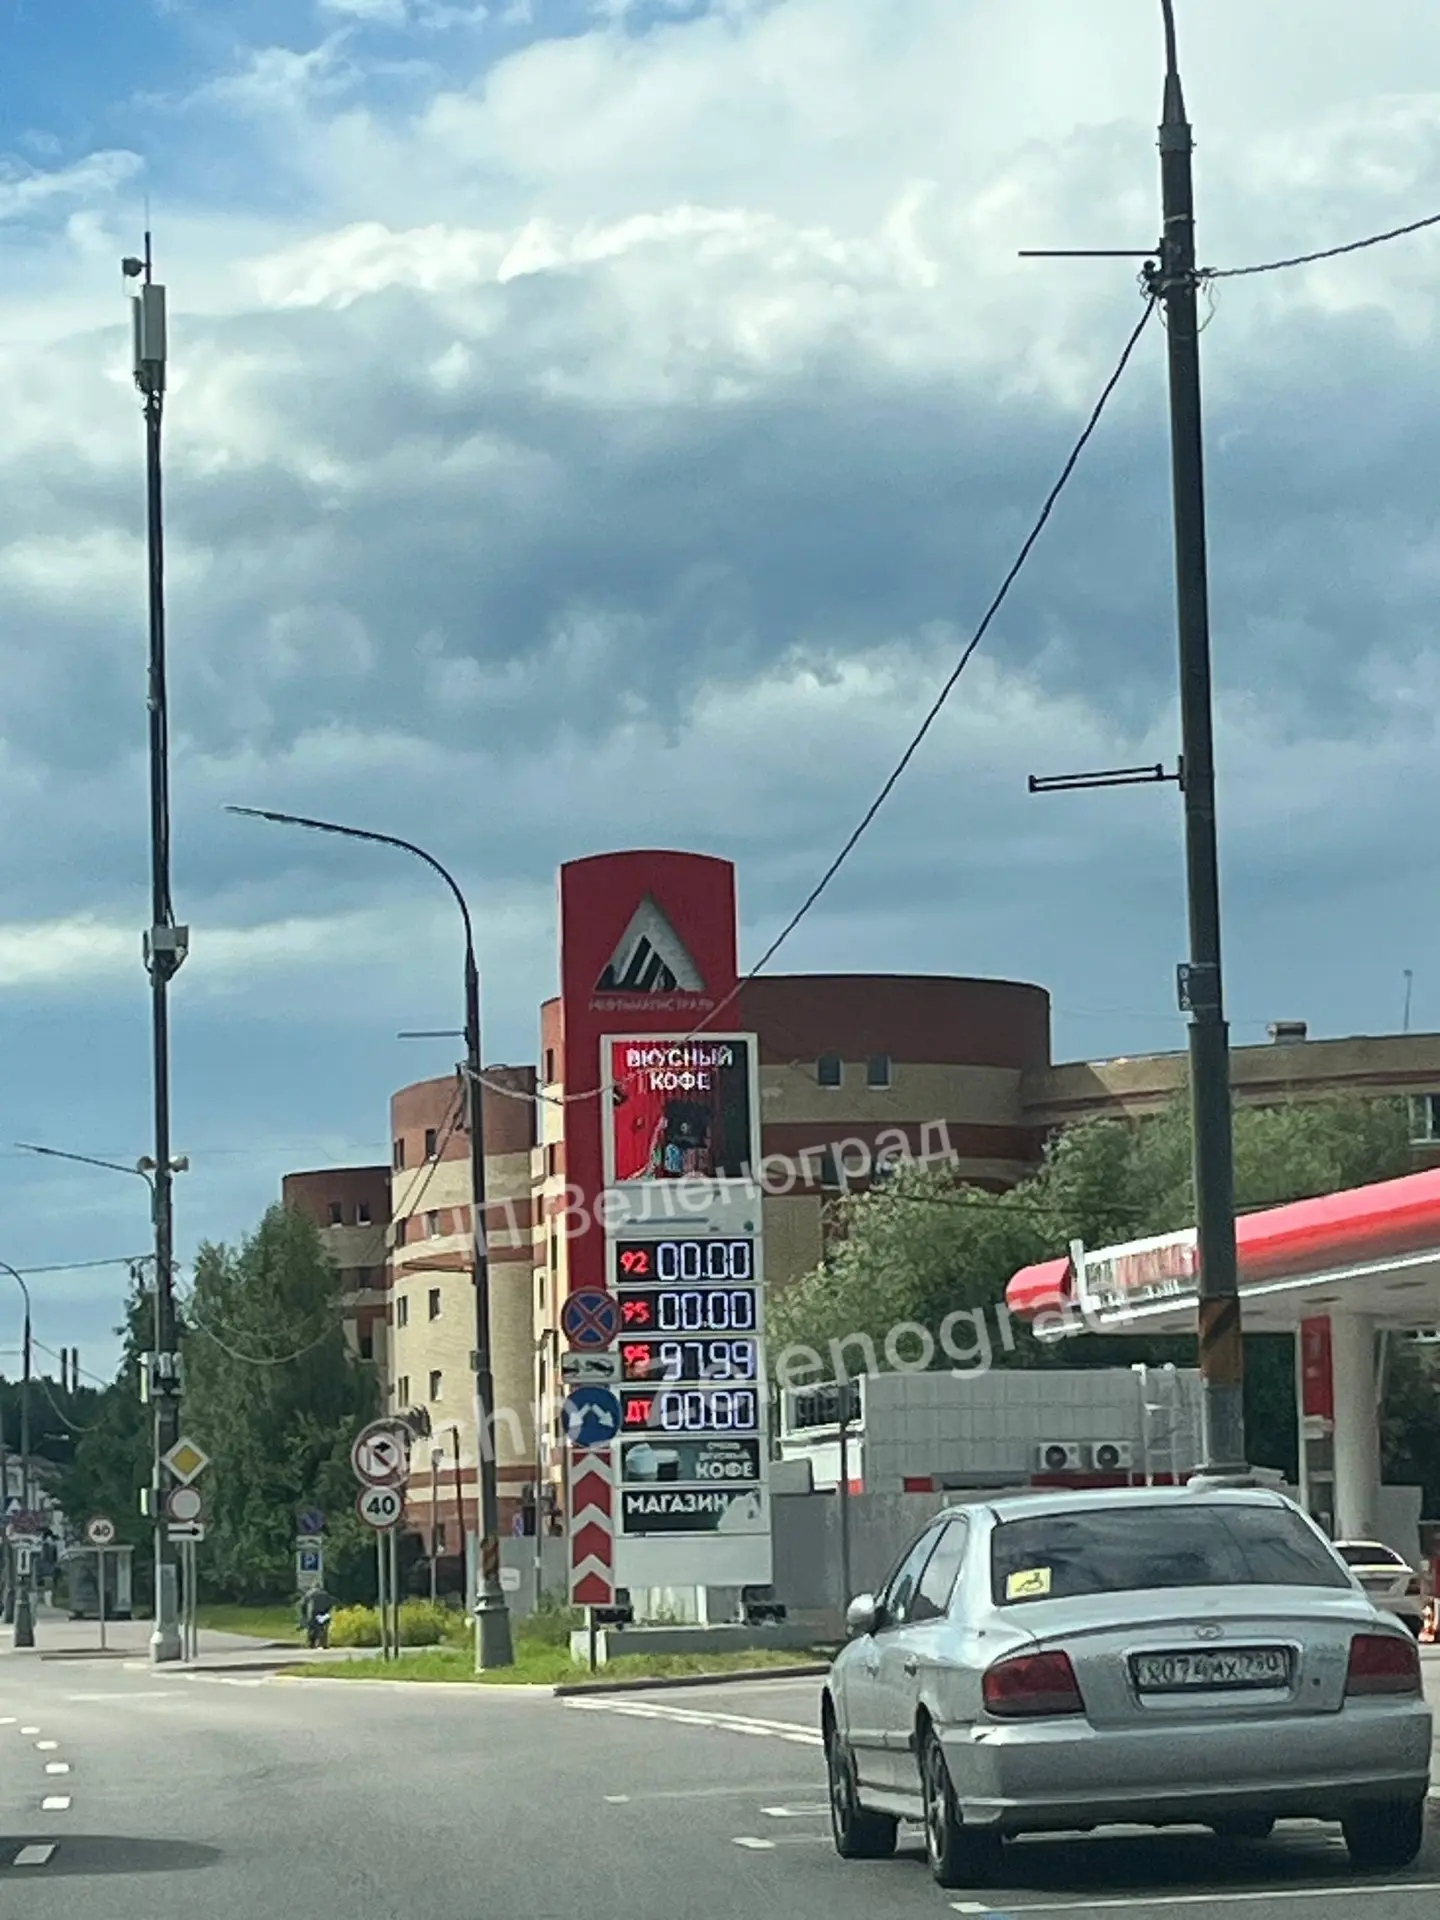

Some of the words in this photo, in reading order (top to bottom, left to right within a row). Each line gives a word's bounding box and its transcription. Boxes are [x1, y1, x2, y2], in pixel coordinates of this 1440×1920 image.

[650, 1072, 711, 1091] КОФЕ
[620, 1250, 650, 1274] 92
[622, 1301, 650, 1324] 95
[623, 1343, 650, 1363] 95
[625, 1399, 652, 1424] ДТ
[695, 1461, 755, 1479] КОФЕ
[366, 1495, 395, 1516] 40
[626, 1493, 729, 1514] МАГАЗИН
[92, 1524, 111, 1536] 40
